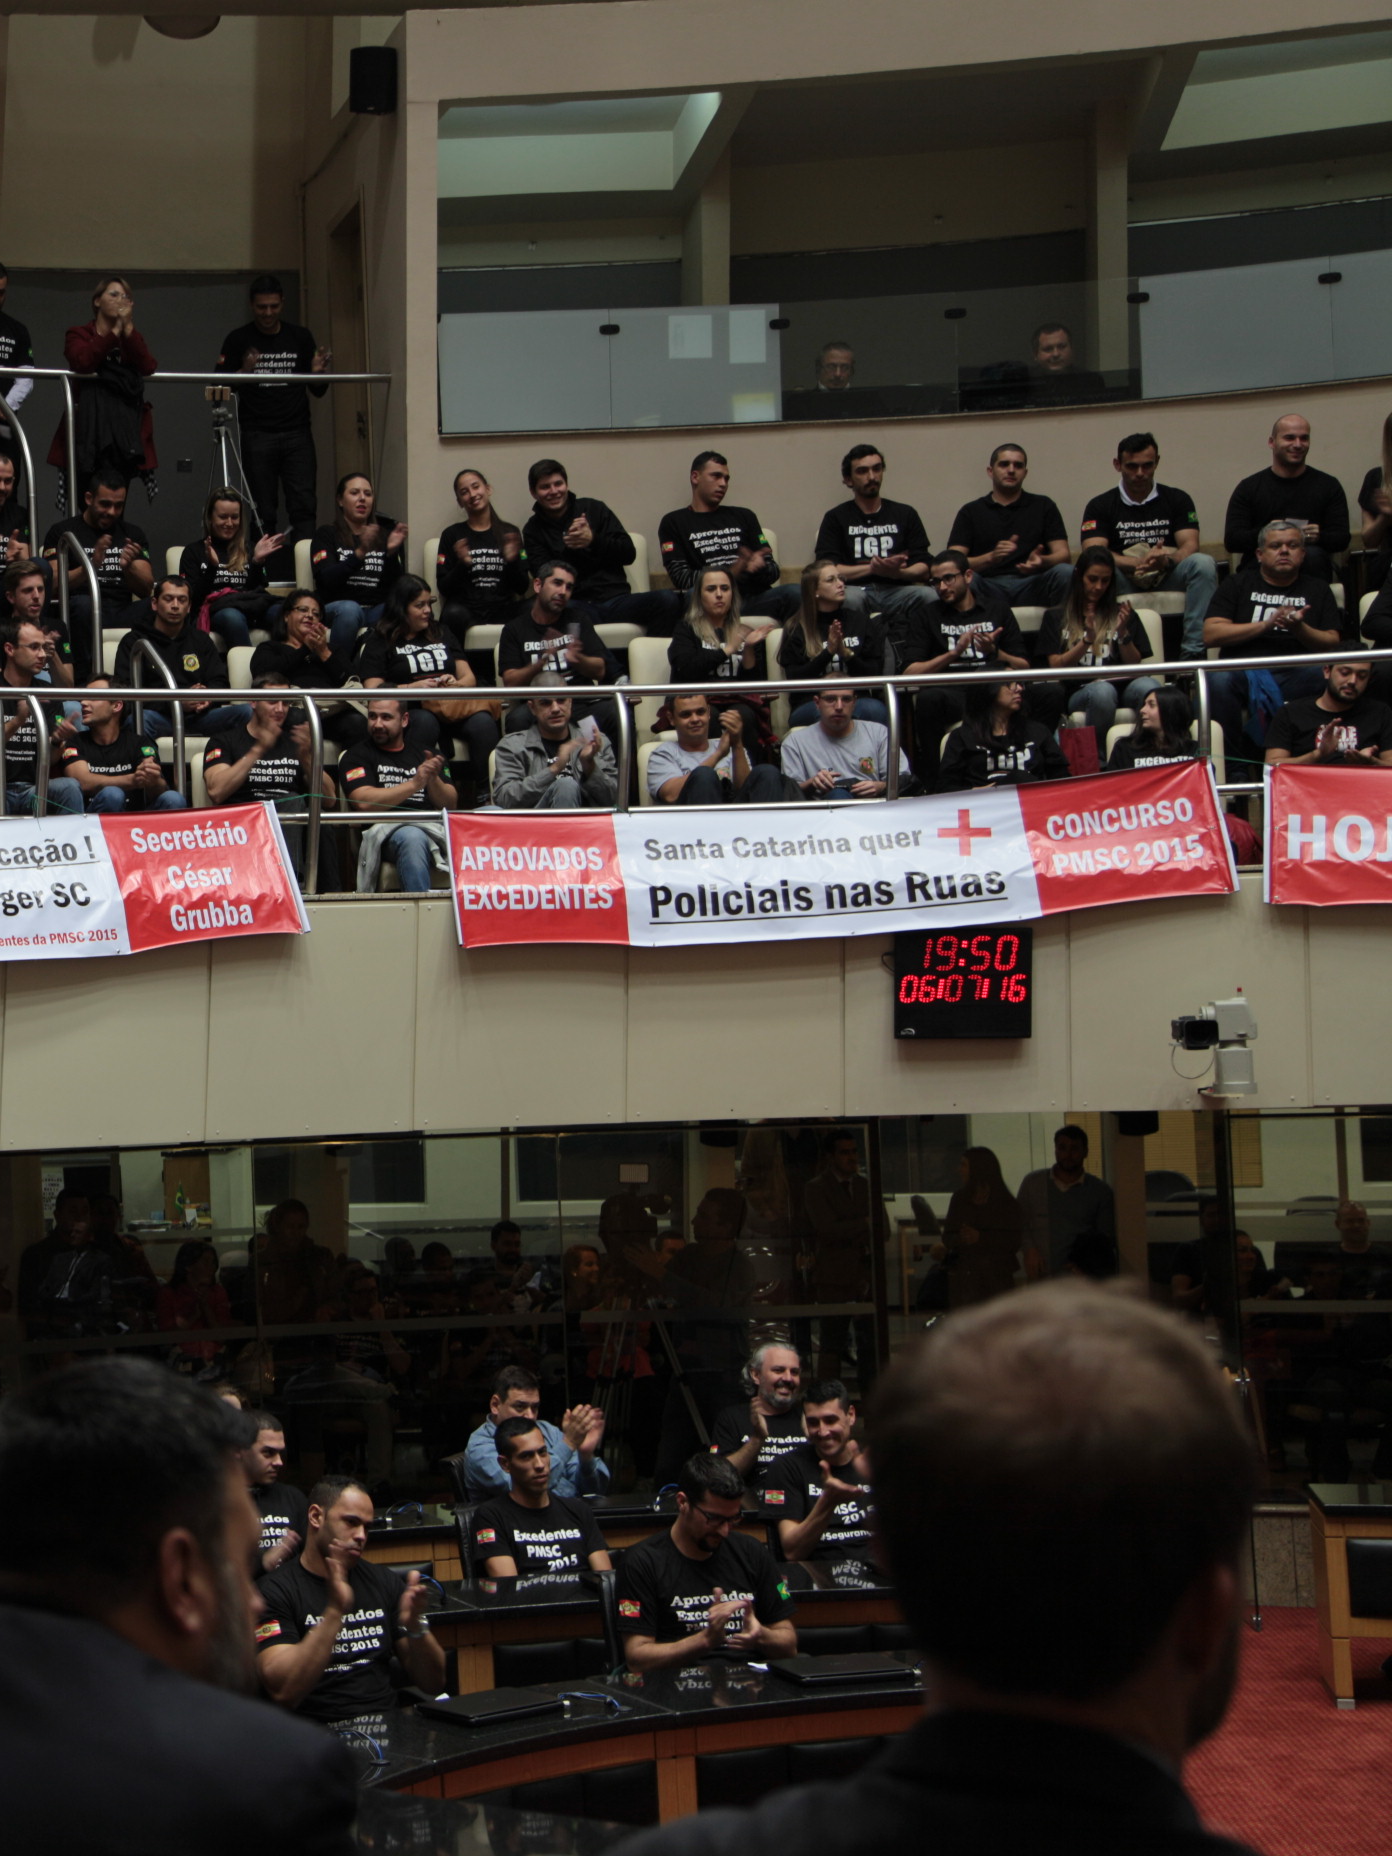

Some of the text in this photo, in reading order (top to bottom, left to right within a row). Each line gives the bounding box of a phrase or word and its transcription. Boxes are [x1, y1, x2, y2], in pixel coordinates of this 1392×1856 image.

[255, 360, 296, 368] xcedentes
[848, 524, 898, 536] EXCEDENTES
[1115, 518, 1169, 529] Aprovados
[689, 527, 741, 541] Aprovados
[693, 536, 740, 548] Excedentes
[854, 536, 894, 559] IGP
[406, 649, 448, 674] IGP
[256, 757, 299, 765] rovados
[250, 767, 297, 776] xcedentes
[1045, 797, 1192, 841] CONCURSO
[131, 821, 247, 853] Secretário
[644, 830, 922, 860] Santa Catarina quer
[82, 836, 95, 865] !
[461, 847, 603, 873] APROVADOS
[1051, 835, 1204, 877] PMSC 2015
[167, 863, 232, 892] César
[53, 883, 90, 907] SC
[464, 883, 612, 909] EXCEDENTES
[649, 872, 1008, 921] Policiais nas Ruas
[170, 900, 253, 931] Grubba
[33, 934, 46, 945] da
[49, 932, 85, 944] PMSC
[88, 929, 117, 941] 2015
[924, 935, 1019, 971] 19:50
[513, 1528, 581, 1542] Excedentes
[526, 1544, 562, 1558] PMSC
[548, 1554, 578, 1572] 2015
[305, 1609, 384, 1626] Apvados
[335, 1624, 384, 1640] edentes
[351, 1639, 380, 1652] 2015
